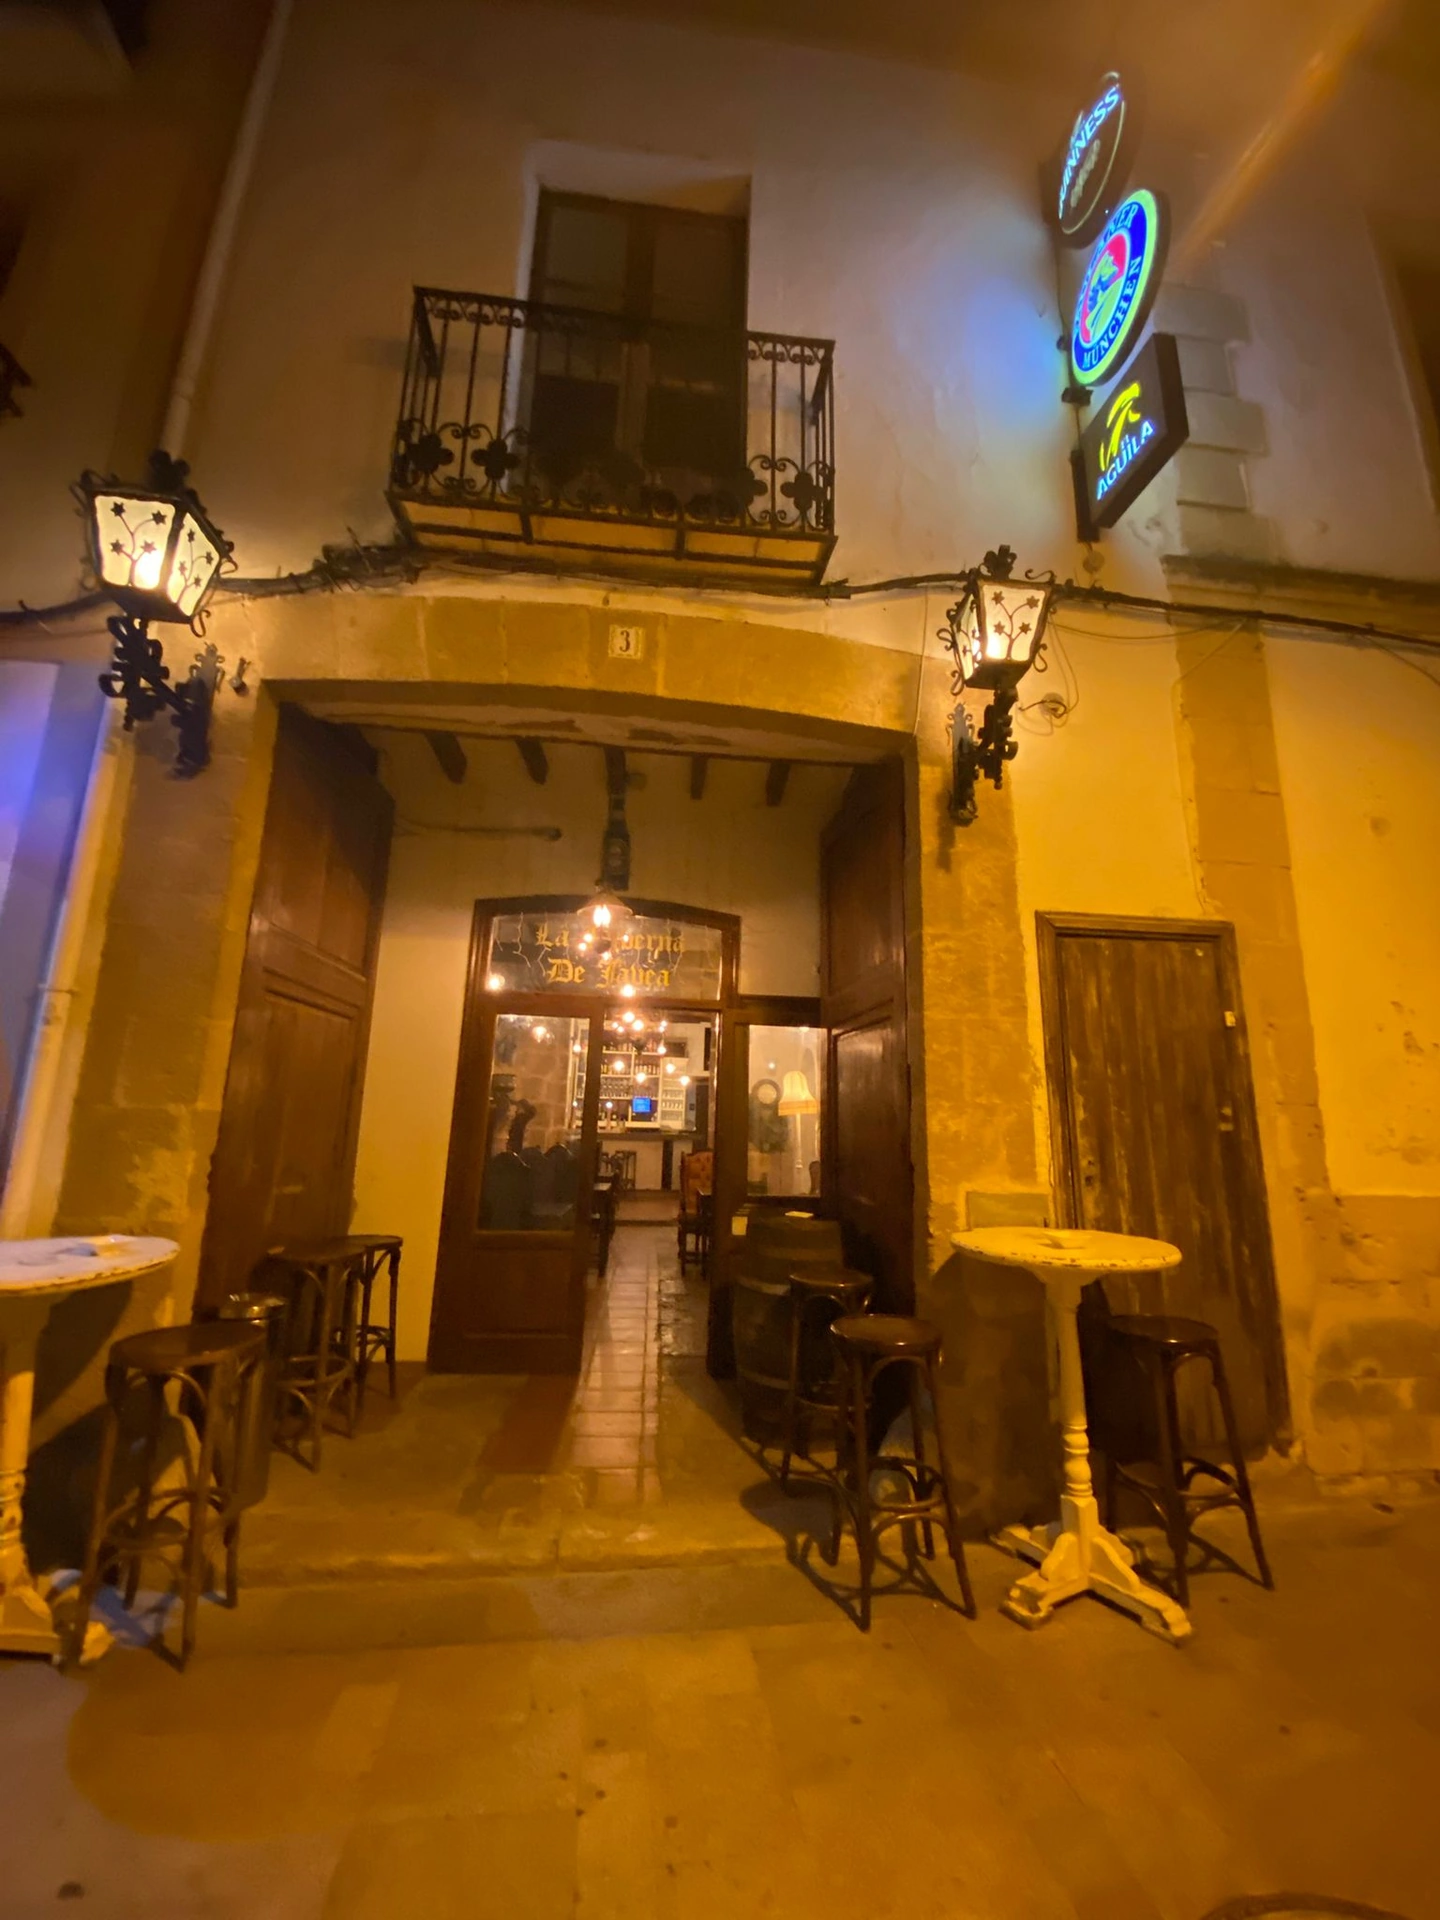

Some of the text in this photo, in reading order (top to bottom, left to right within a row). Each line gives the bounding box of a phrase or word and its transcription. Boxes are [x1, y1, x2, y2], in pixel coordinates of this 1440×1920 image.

[619, 629, 631, 653] 3
[535, 922, 570, 947] La
[547, 957, 586, 984] De
